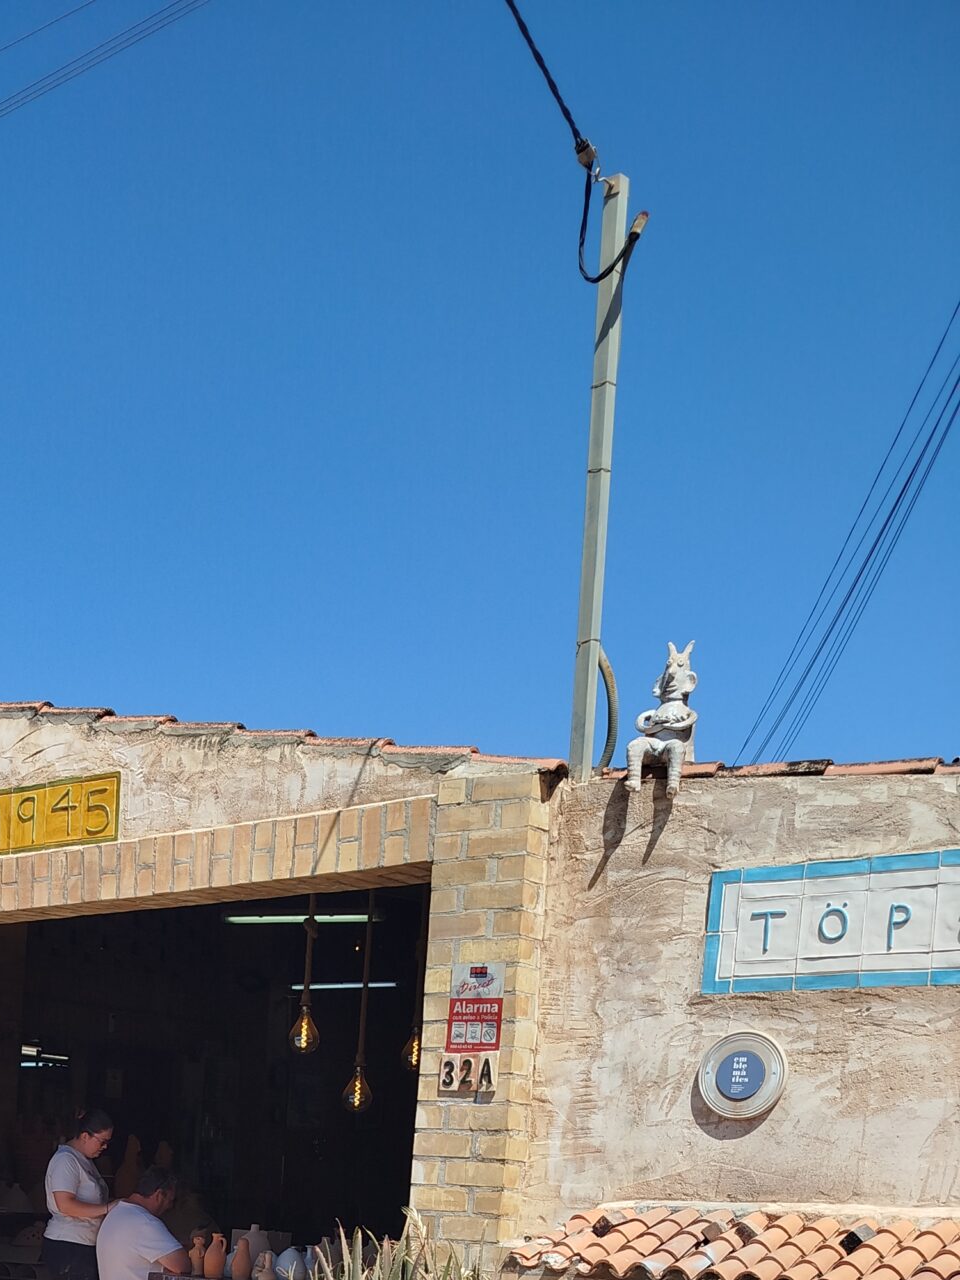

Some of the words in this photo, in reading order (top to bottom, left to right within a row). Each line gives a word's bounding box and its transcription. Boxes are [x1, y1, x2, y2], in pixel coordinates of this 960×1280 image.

[749, 900, 960, 952] TÖP
[453, 1000, 499, 1014] Alarma
[441, 1058, 493, 1089] 32A
